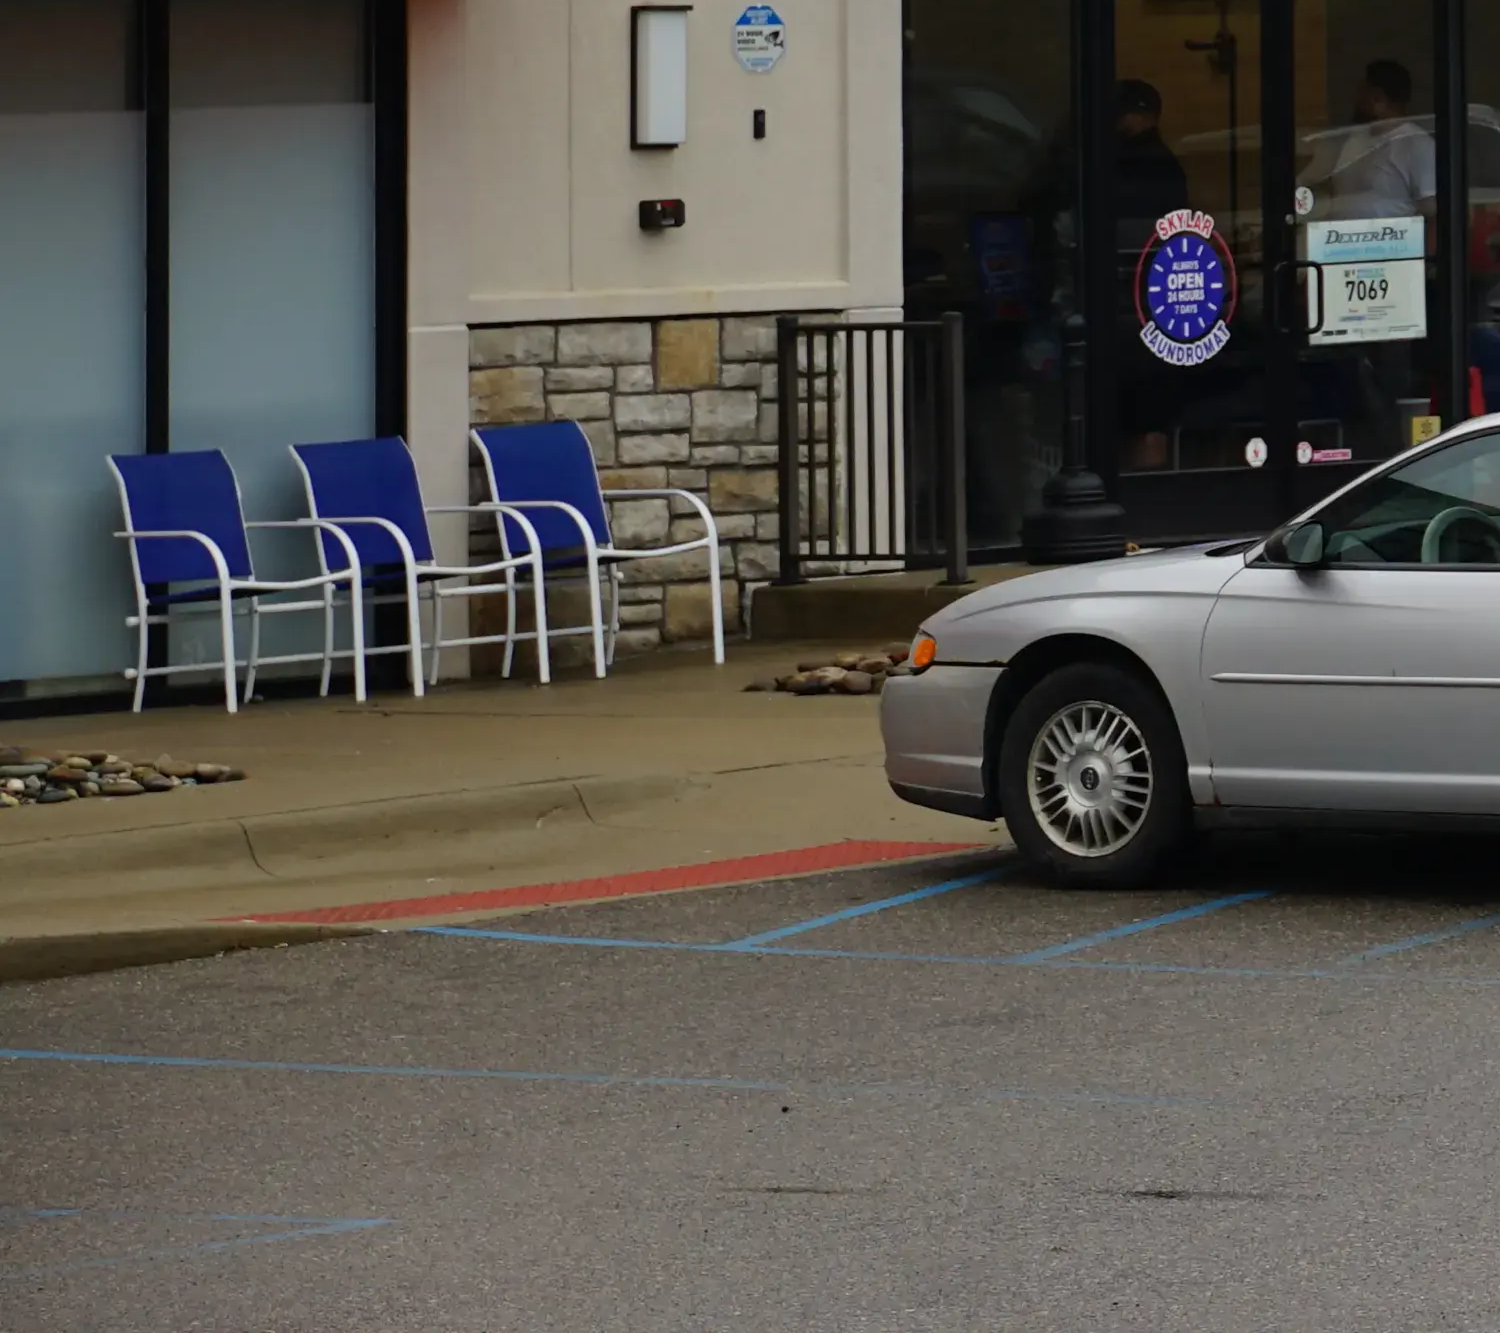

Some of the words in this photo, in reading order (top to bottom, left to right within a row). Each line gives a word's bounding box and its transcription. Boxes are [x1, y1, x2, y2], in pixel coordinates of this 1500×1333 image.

[1157, 210, 1214, 238] SKYLAR
[1167, 272, 1205, 290] OPEN
[1345, 279, 1389, 302] 7069
[1142, 322, 1230, 364] LAUNDROMAT
